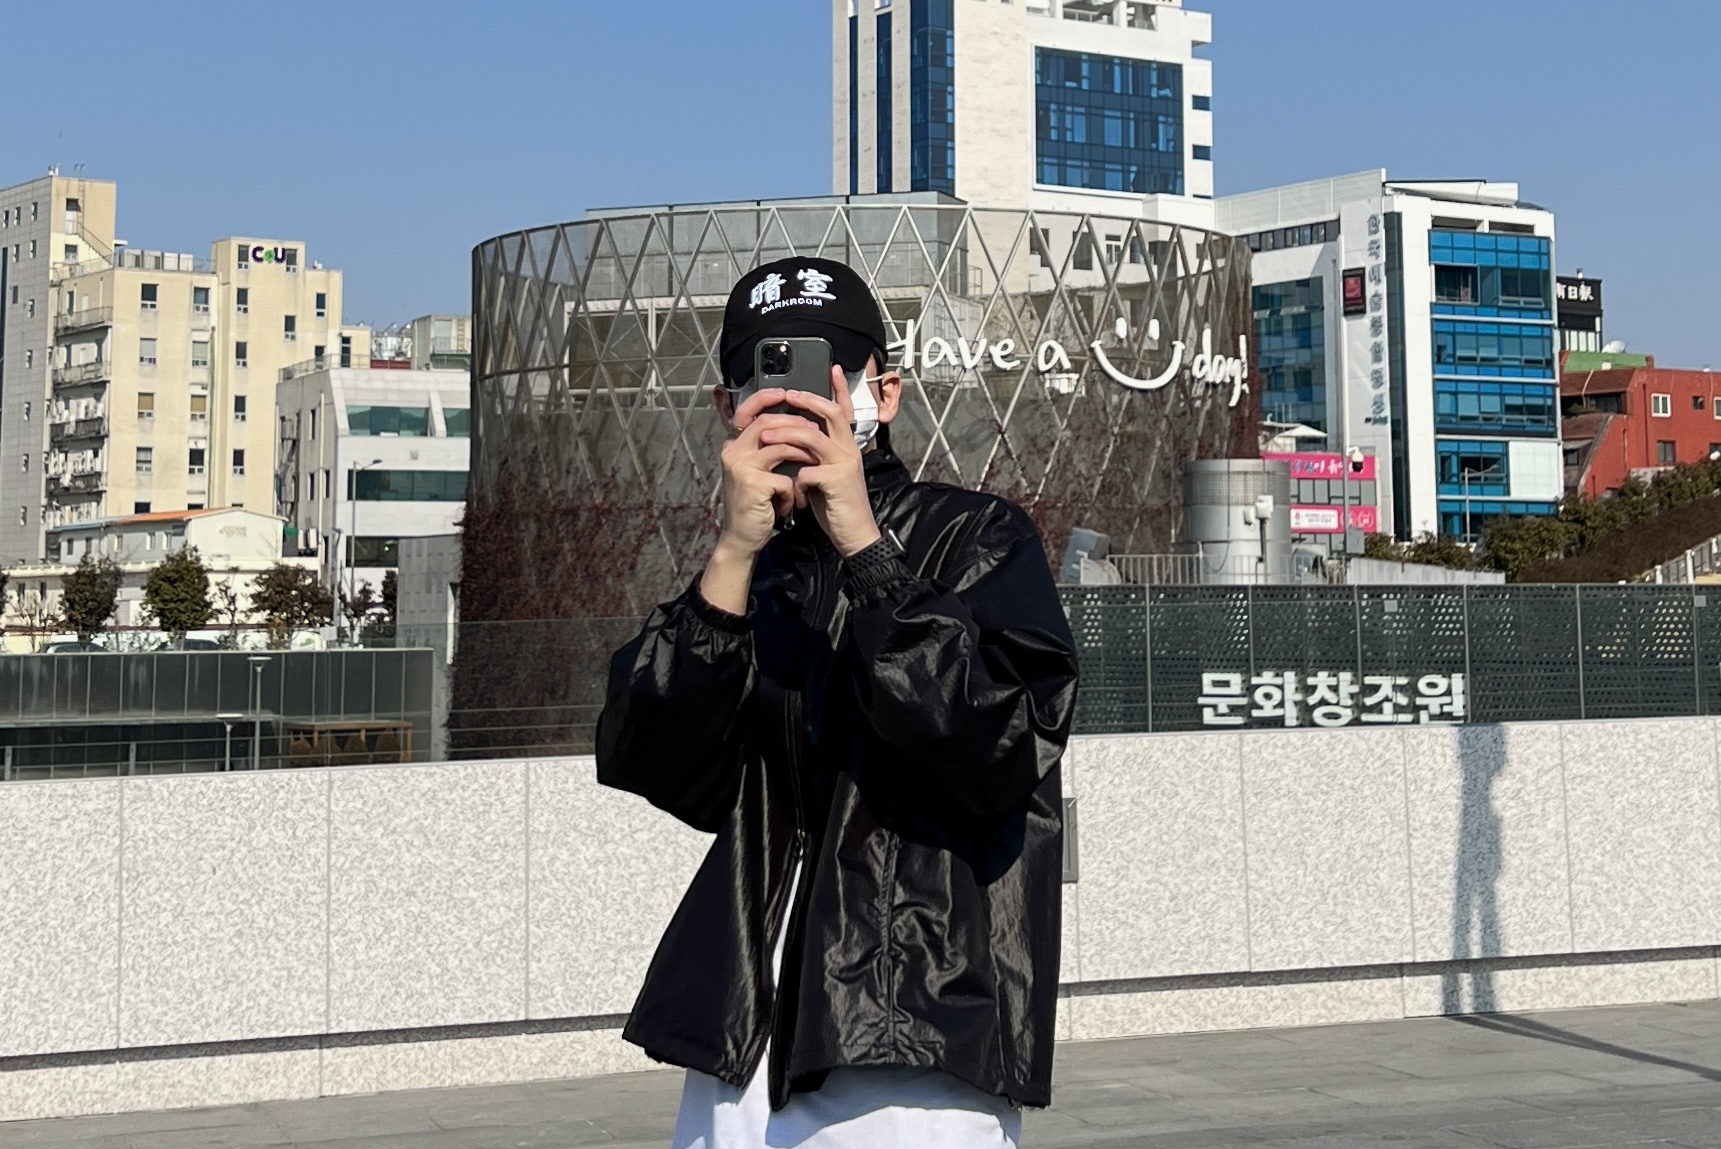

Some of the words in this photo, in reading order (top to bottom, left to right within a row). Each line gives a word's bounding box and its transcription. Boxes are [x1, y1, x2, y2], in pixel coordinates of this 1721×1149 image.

[251, 246, 286, 263] CU
[749, 268, 837, 309] 暗室
[761, 298, 823, 315] DARKROOM
[1037, 339, 1071, 372] a
[1192, 328, 1249, 407] day!
[1197, 671, 1465, 727] 문화창조원
